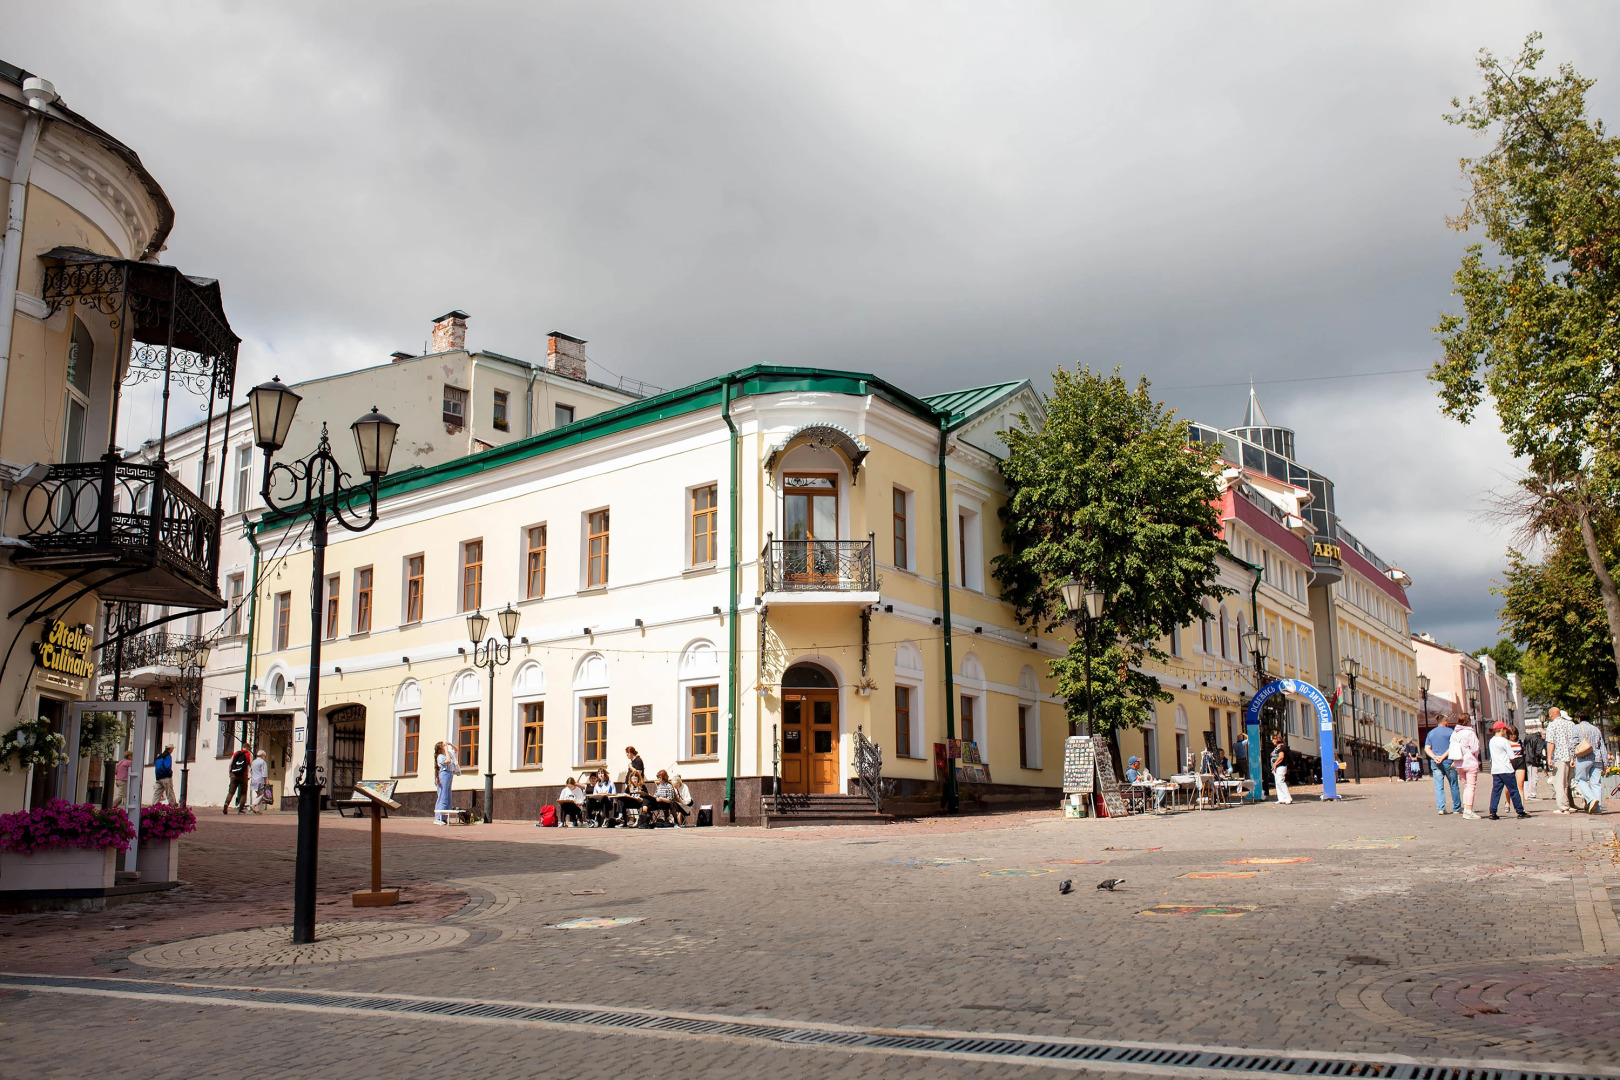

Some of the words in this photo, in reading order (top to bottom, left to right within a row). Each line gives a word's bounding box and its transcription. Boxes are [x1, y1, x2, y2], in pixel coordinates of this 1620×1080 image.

[48, 619, 93, 654] Atelier
[38, 642, 94, 679] Culinaire
[1250, 685, 1276, 713] ОСВЕЖИСЬ
[1298, 684, 1329, 723] ПО-ВИТЕБСКИ
